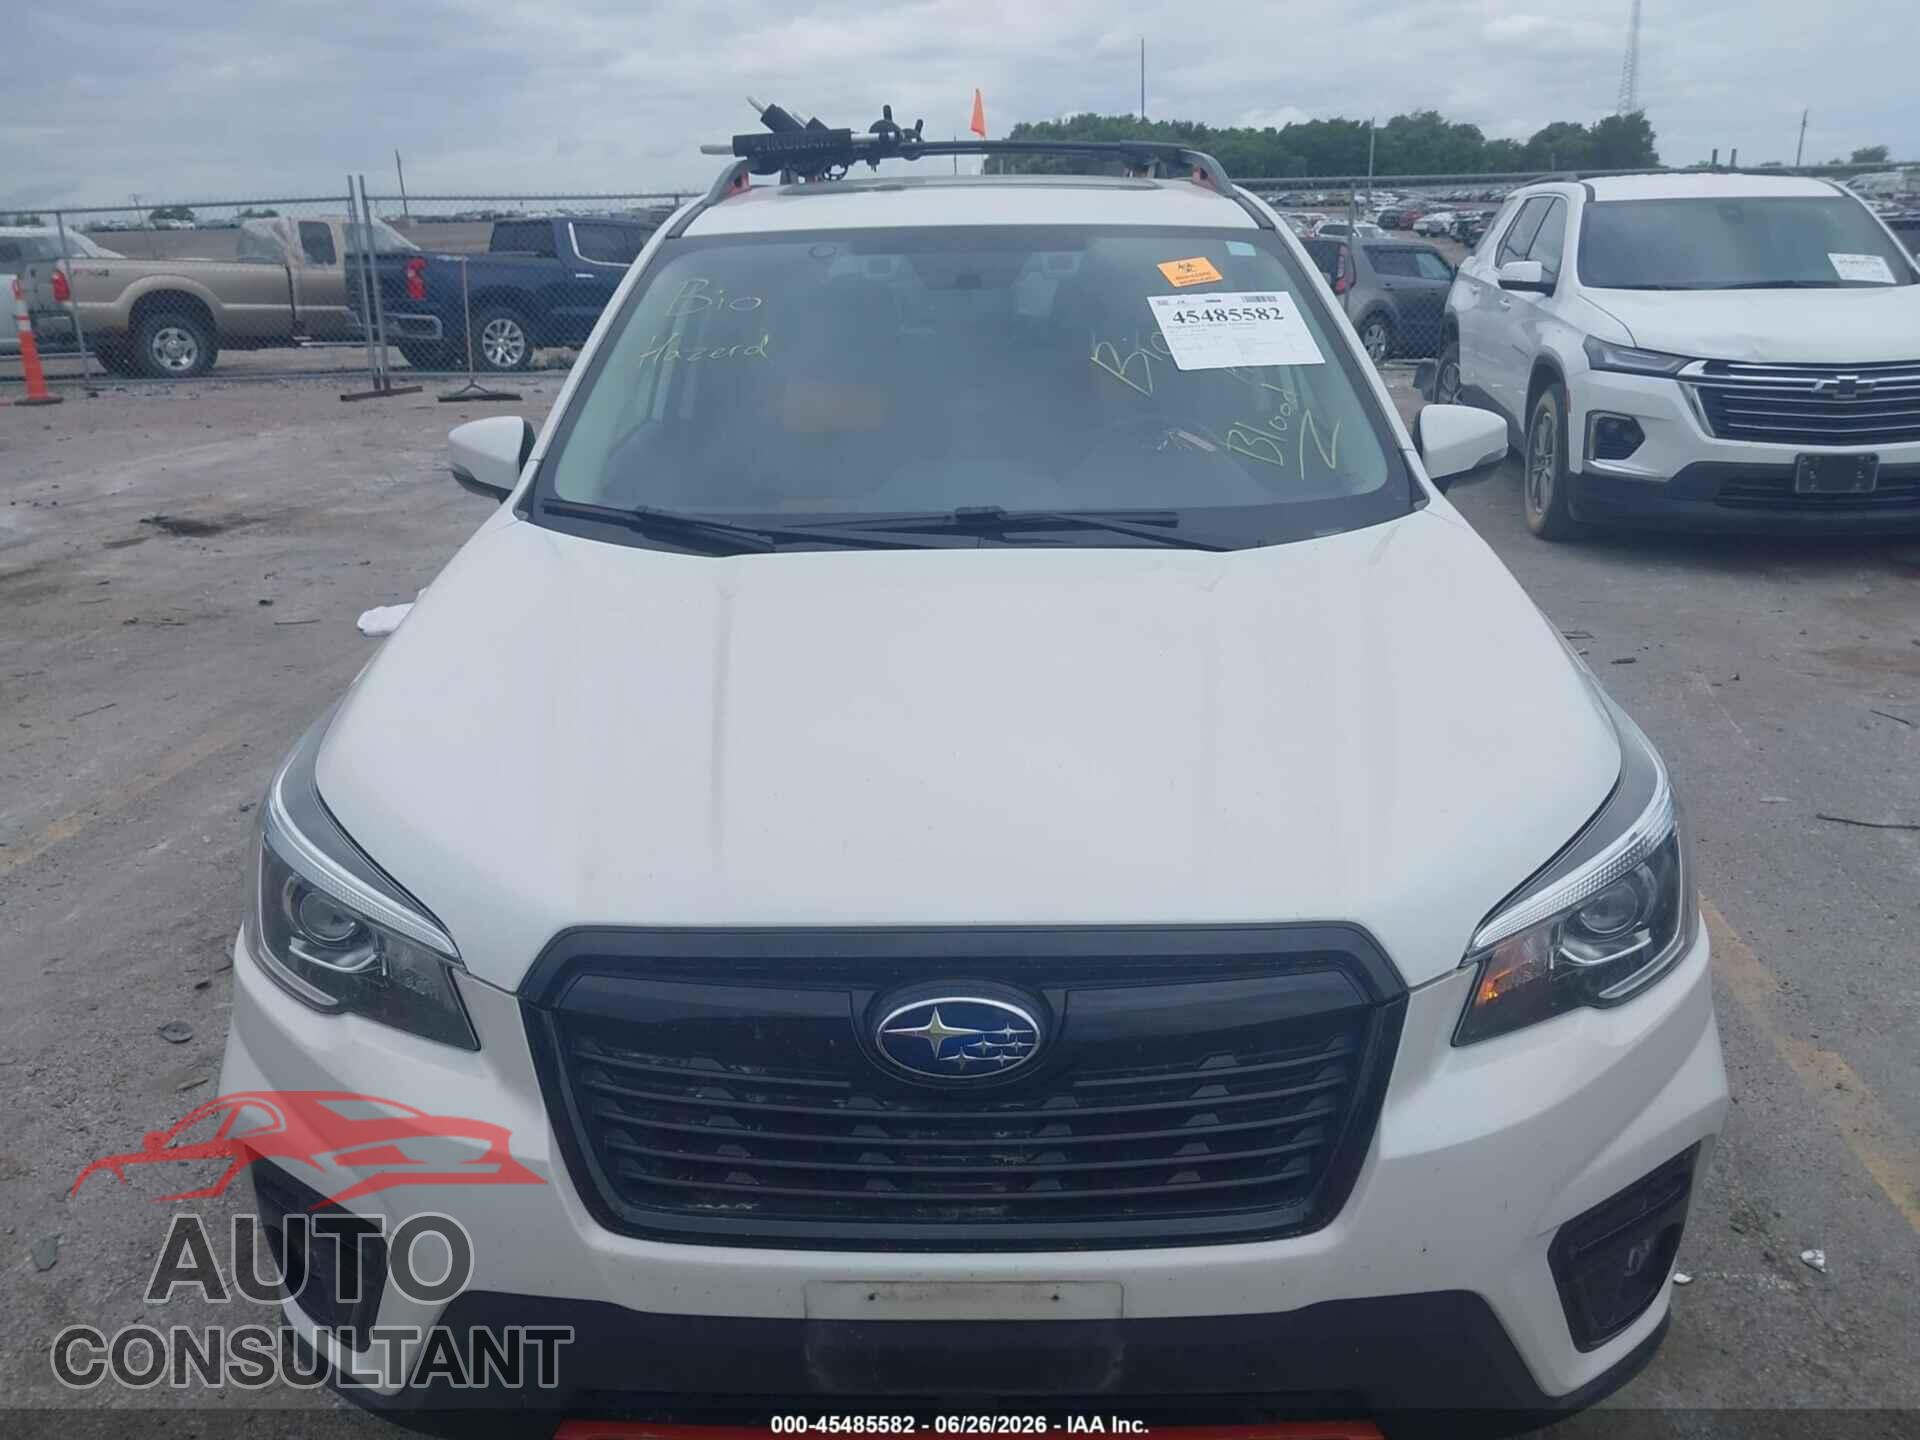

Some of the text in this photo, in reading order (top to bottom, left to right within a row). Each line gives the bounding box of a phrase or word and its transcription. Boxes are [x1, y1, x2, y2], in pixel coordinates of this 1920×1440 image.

[666, 278, 761, 316] Bio
[1173, 307, 1284, 324] 45485582
[1226, 383, 1298, 466] Blood
